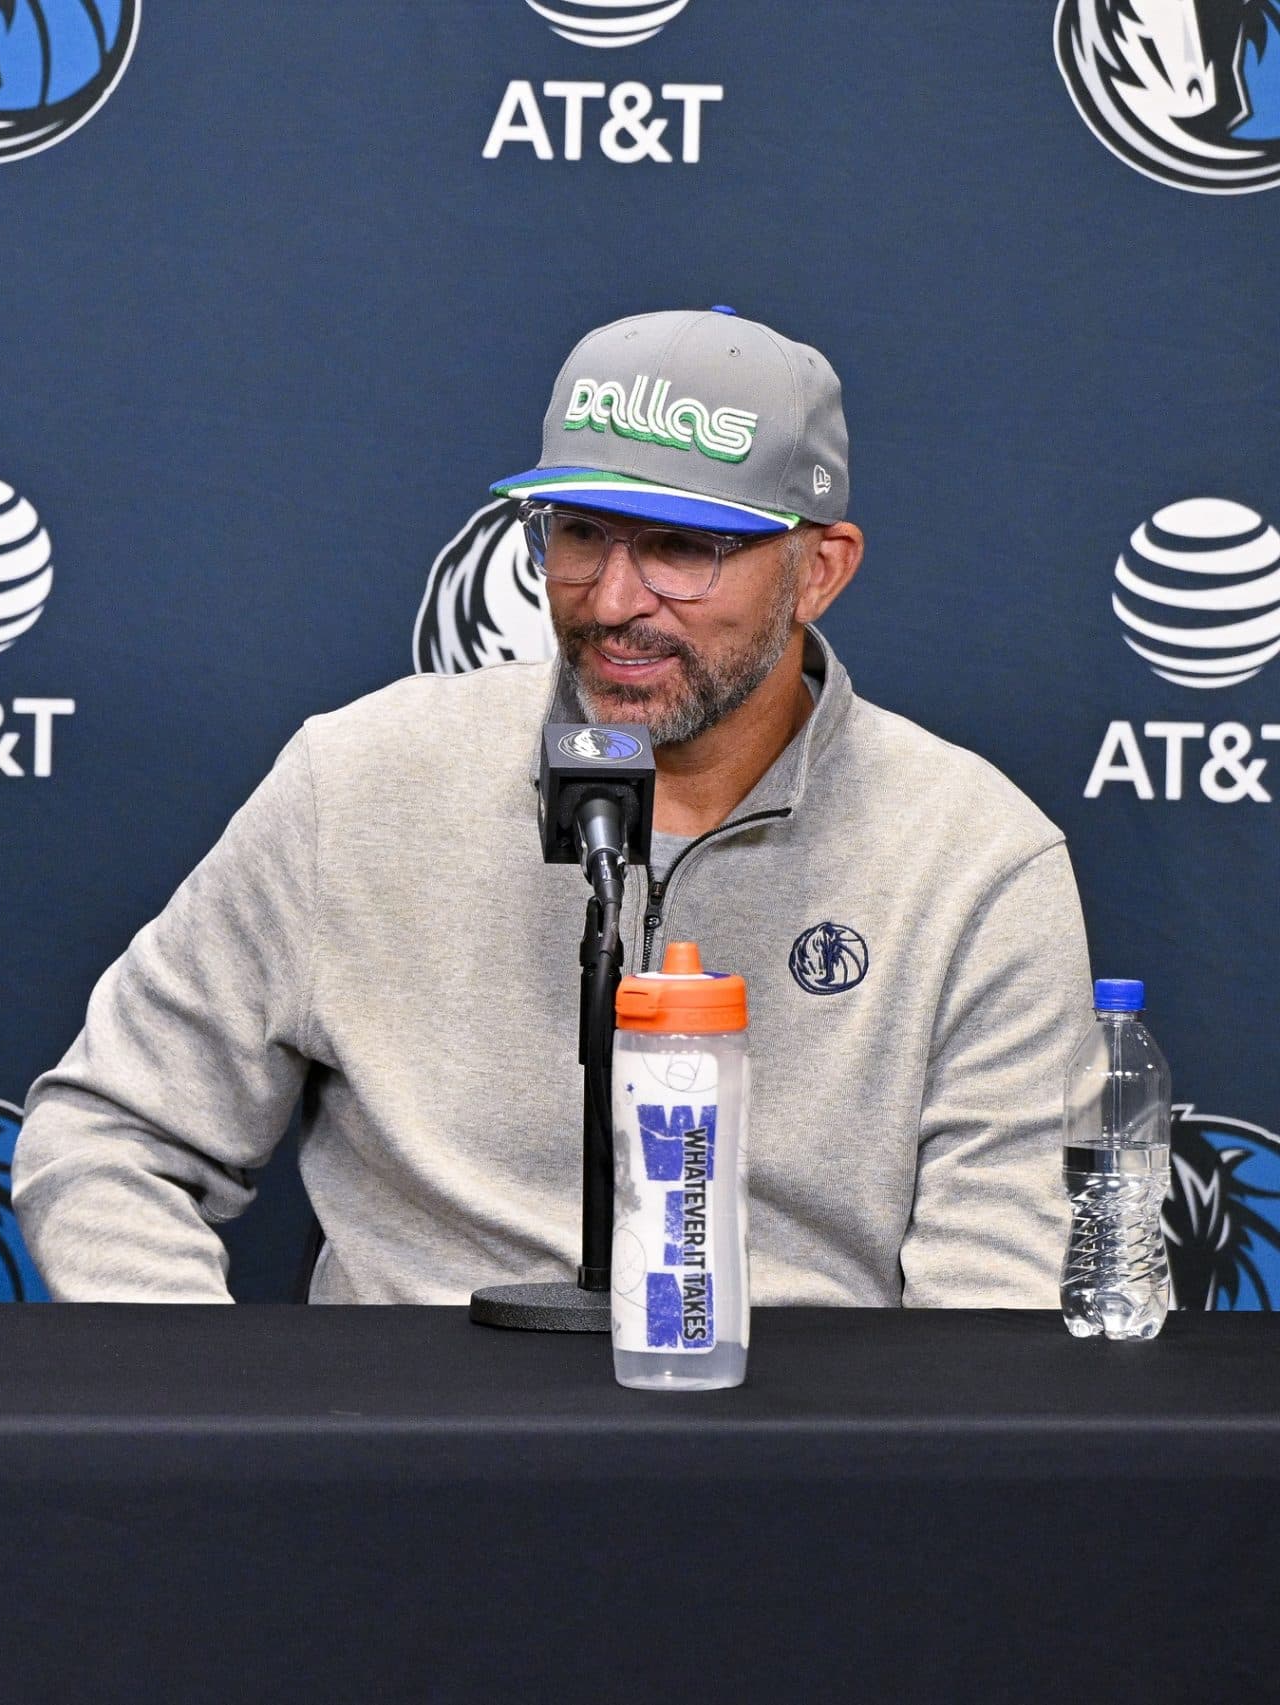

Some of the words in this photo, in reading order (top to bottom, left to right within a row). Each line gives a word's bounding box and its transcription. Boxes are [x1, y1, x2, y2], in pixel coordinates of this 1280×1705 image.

[482, 80, 724, 164] AT&T
[683, 1127, 707, 1246] WHATEVER
[683, 1251, 706, 1269] IT
[682, 1271, 707, 1341] TAKES
